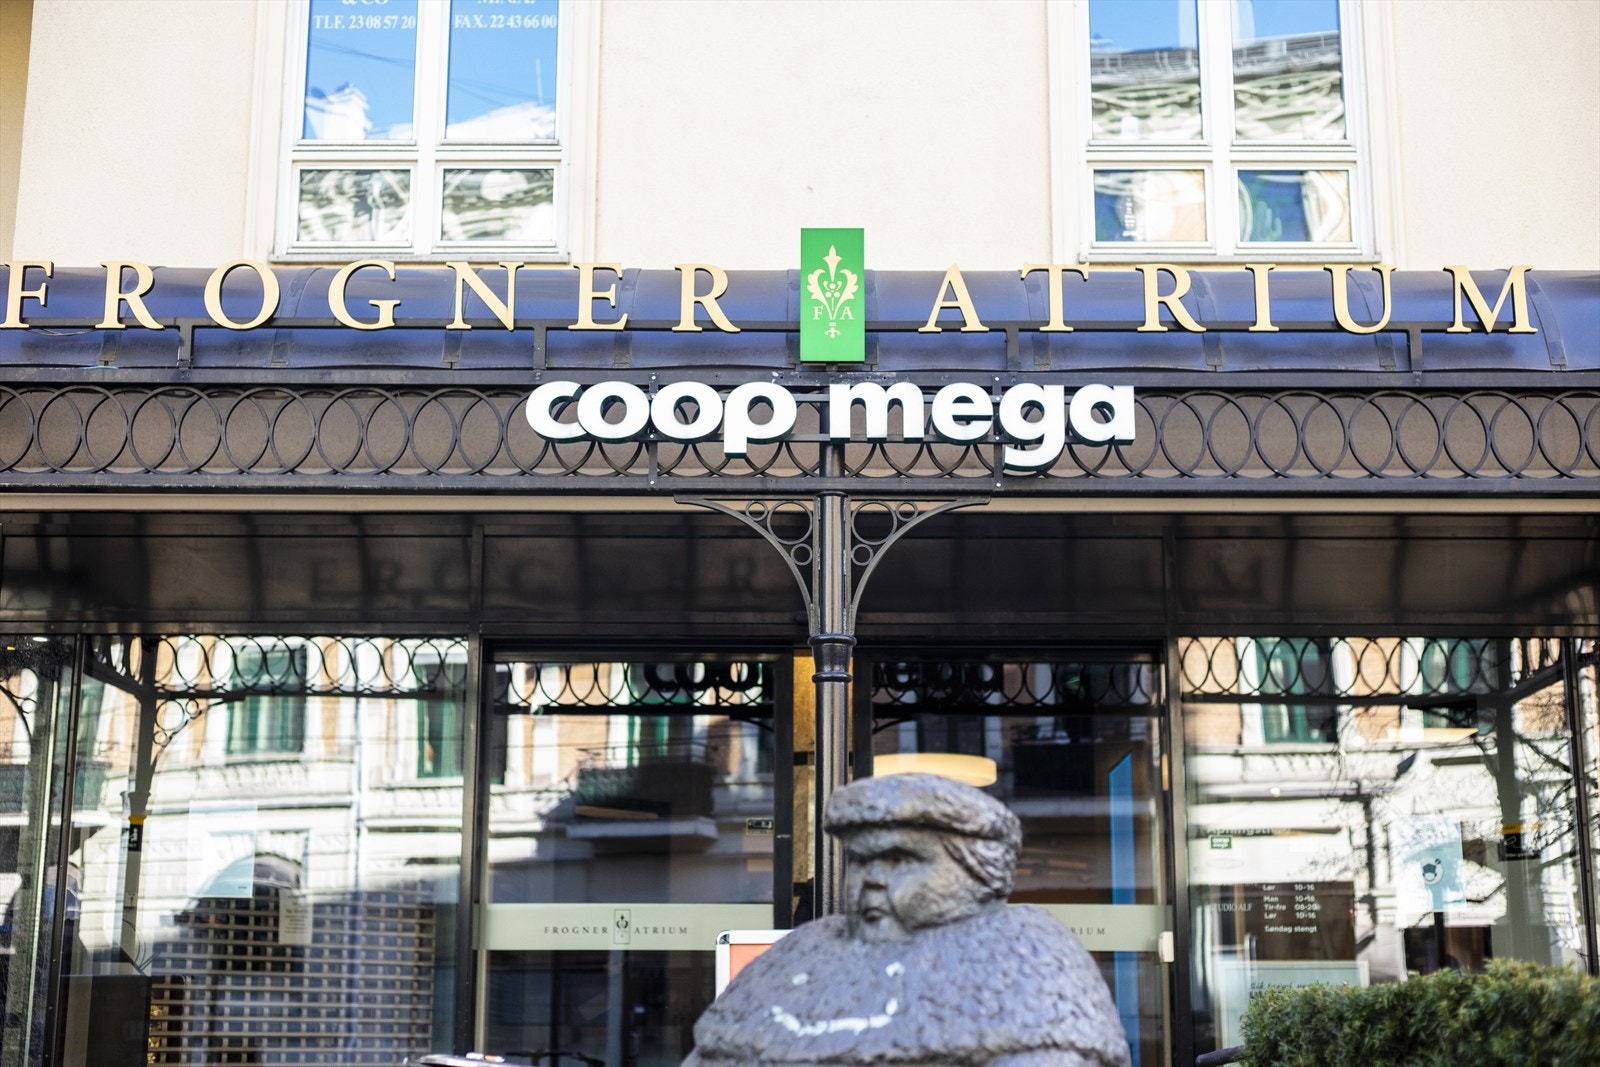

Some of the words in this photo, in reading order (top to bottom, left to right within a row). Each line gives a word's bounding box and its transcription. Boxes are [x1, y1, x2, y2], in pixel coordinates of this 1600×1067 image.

[314, 15, 346, 29] TLF.
[454, 14, 488, 29] FAX.
[0, 259, 741, 333] FROGNER
[918, 263, 1539, 335] ATRIUM
[525, 380, 797, 459] coop
[829, 380, 1137, 475] mega
[544, 926, 608, 935] FROGNER
[634, 926, 688, 935] ATRIUM
[1071, 927, 1105, 936] RIUM
